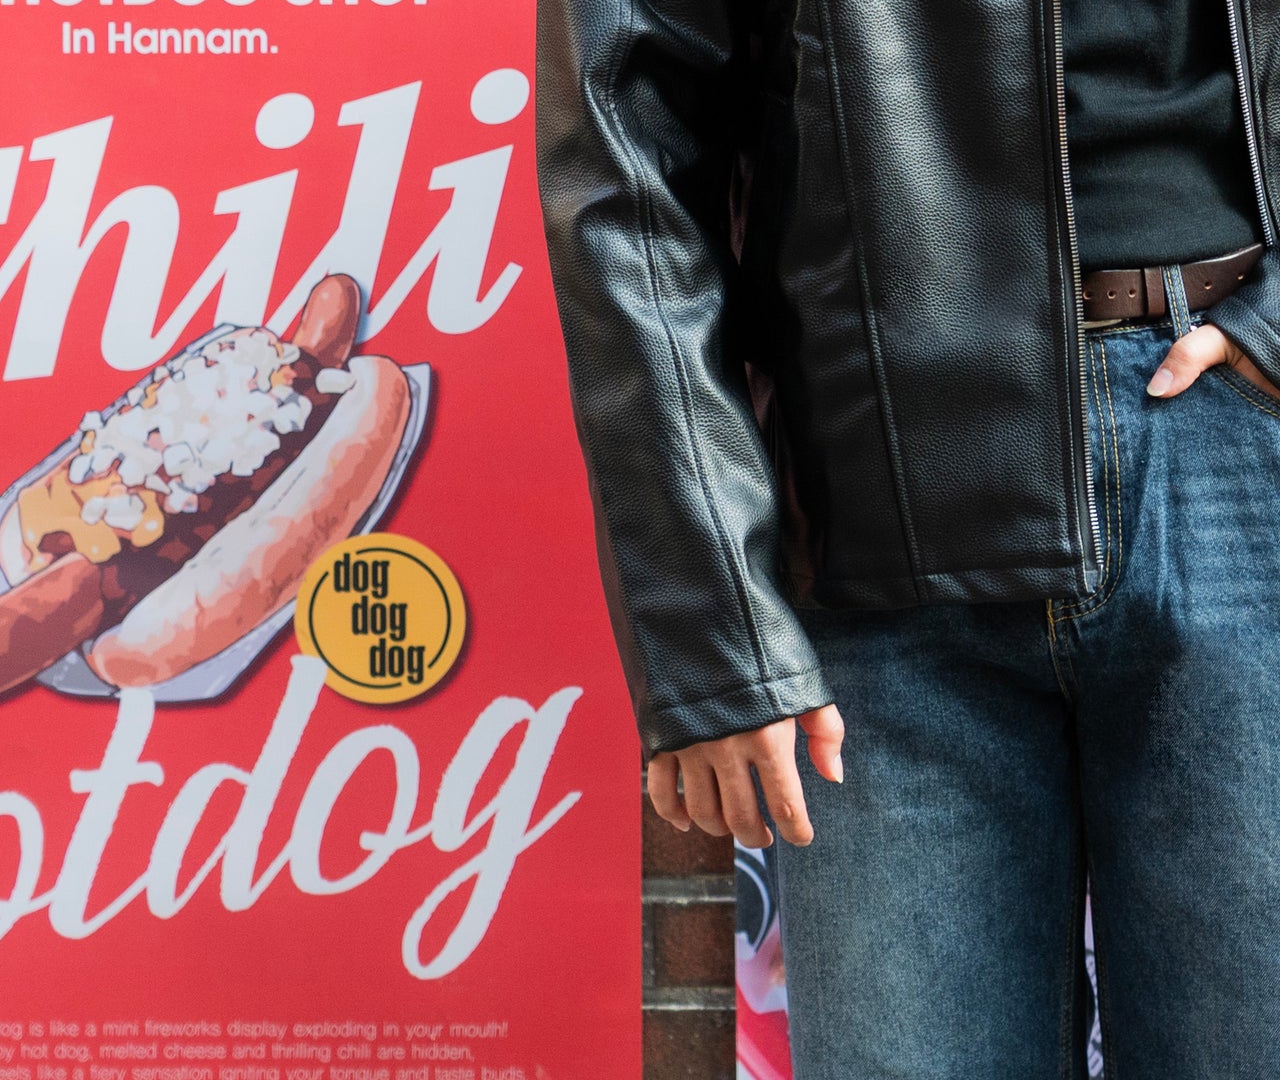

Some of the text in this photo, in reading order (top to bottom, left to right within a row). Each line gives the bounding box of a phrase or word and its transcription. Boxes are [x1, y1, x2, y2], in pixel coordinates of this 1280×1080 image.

[63, 21, 279, 54] In Hannam.
[333, 552, 390, 599] dog
[352, 595, 408, 642] dog
[369, 638, 426, 685] dog
